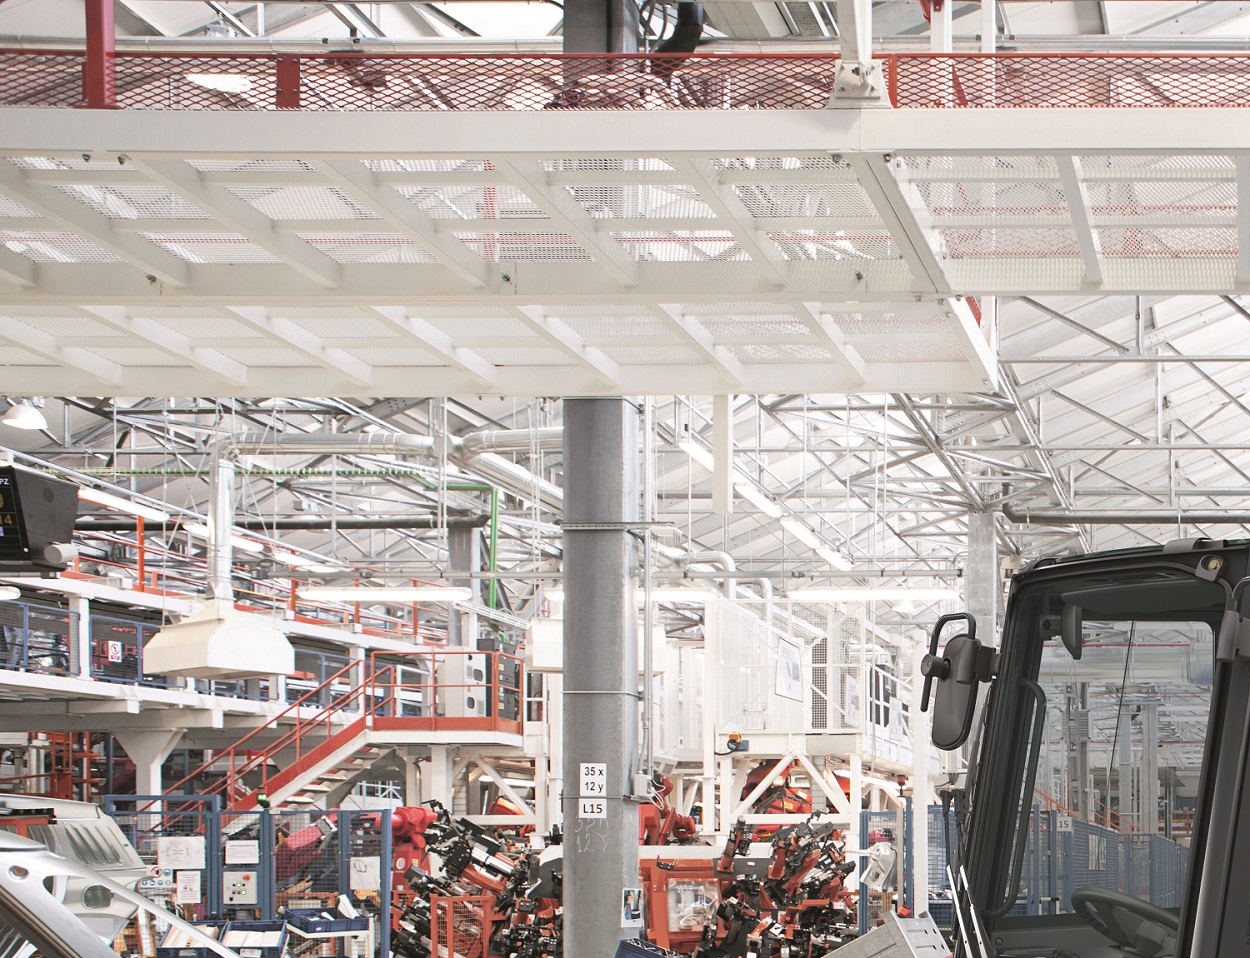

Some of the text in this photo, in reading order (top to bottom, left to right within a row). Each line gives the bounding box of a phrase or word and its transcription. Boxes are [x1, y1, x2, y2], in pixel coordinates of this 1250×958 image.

[584, 767, 604, 776] 35 x
[585, 781, 604, 793] 12 y
[583, 804, 603, 814] L15
